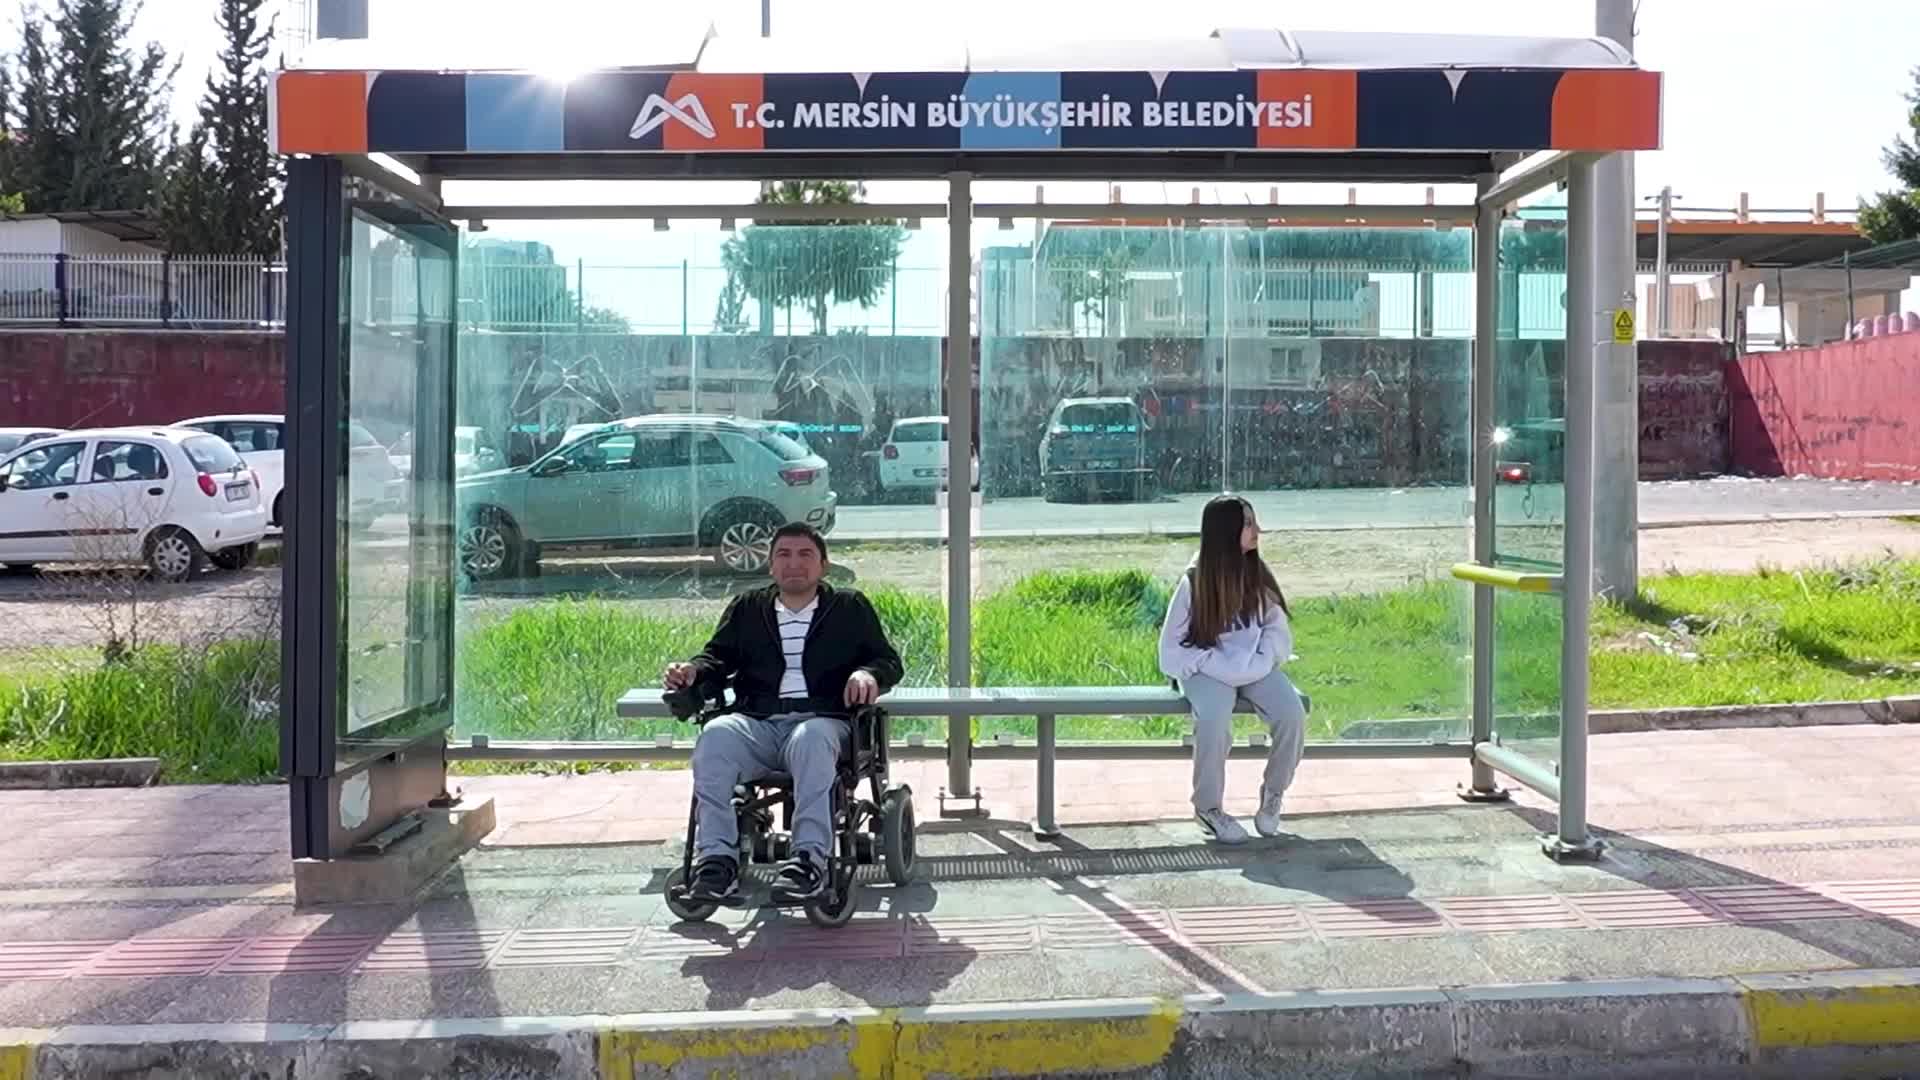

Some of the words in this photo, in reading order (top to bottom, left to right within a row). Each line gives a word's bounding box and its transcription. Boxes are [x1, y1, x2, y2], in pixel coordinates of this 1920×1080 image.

[731, 102, 786, 129] T.C.
[793, 94, 915, 128] MERSİN
[927, 94, 1132, 135] BÜYÜKŞEHİR
[1143, 94, 1312, 127] BELEDİYESİ
